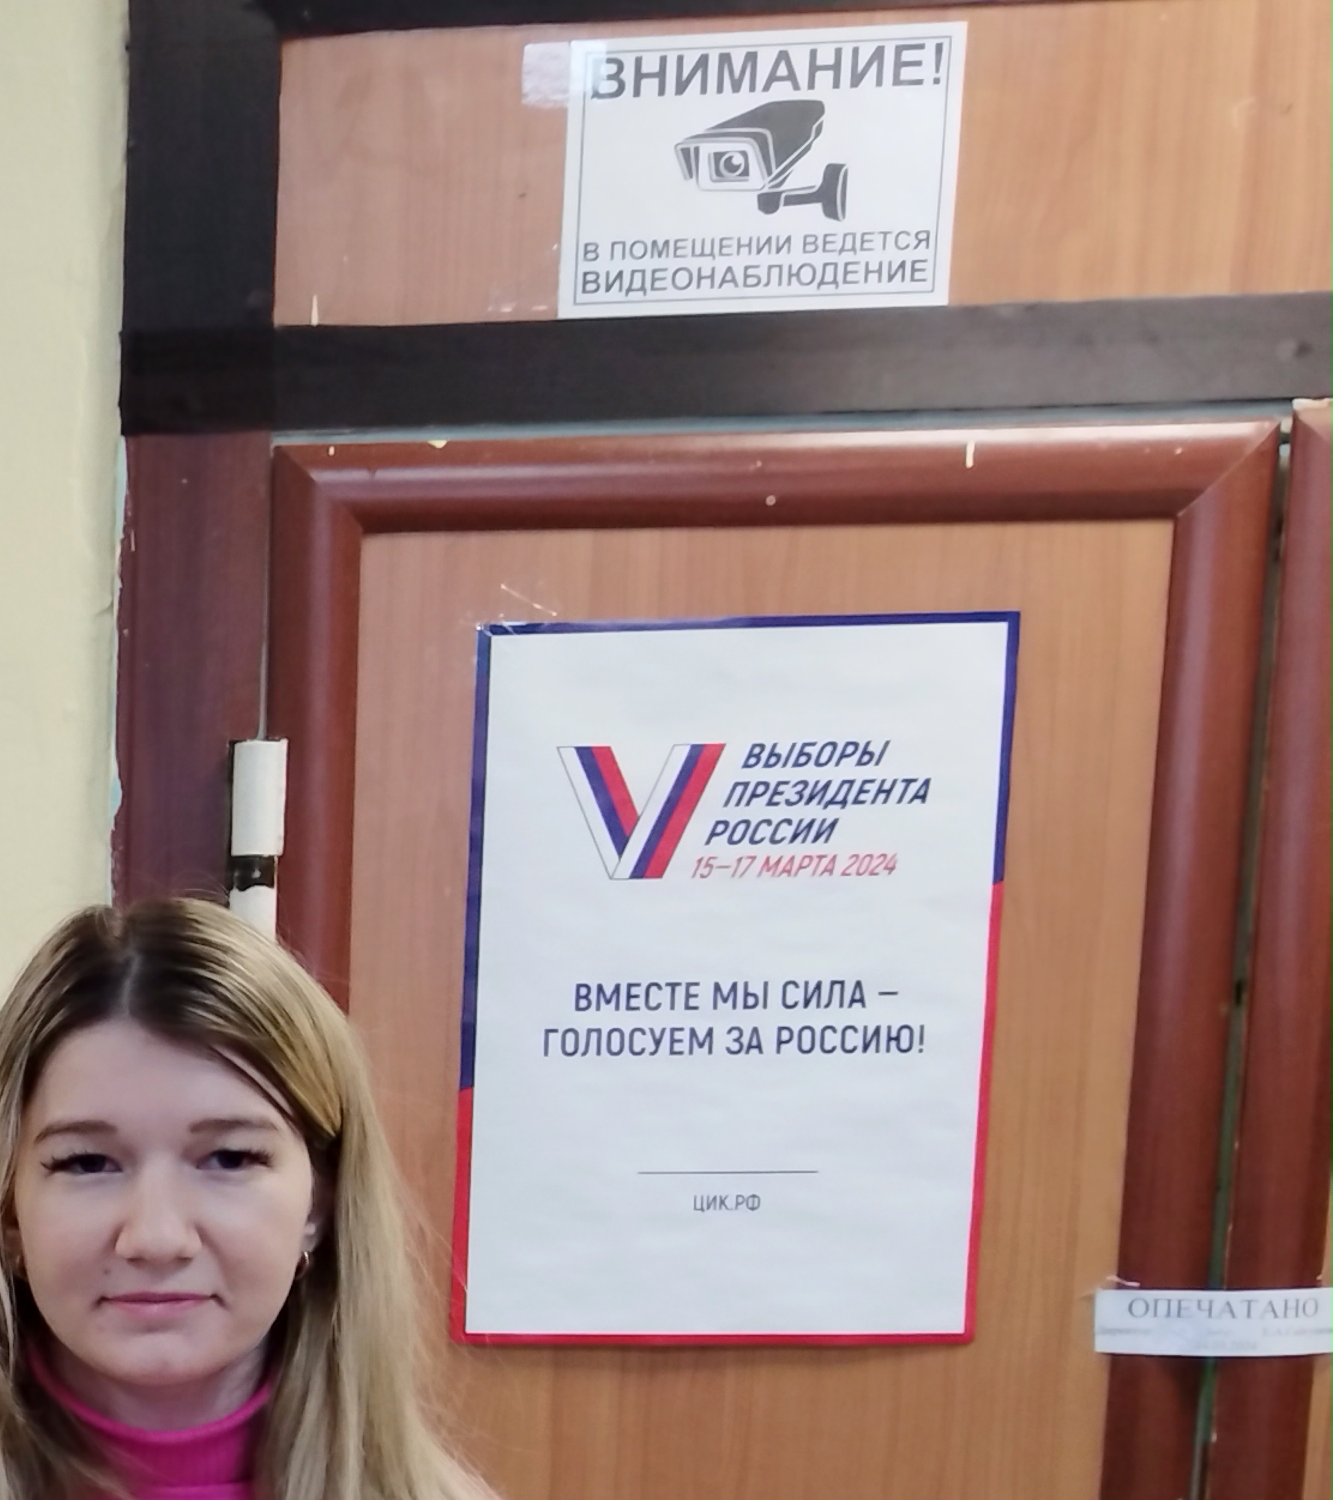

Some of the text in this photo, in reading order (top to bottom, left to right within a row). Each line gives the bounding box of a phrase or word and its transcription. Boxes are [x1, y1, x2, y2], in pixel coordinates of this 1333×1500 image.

[591, 42, 944, 100] ВНИМАНИЕ!
[583, 229, 930, 262] В ПОМЕЩЕНИИ ВЕДЕТСЯ
[581, 259, 928, 296] ВИДЕОНАБЛЮДЕНИЕ
[741, 740, 890, 769] ВЫБОРЫ
[723, 777, 932, 810] ПРЕЗИДЕНТА
[705, 818, 839, 846] РОССИИ
[757, 854, 836, 878] МАРТА
[840, 853, 899, 877] 2024
[574, 981, 700, 1012] ВМЕСТЕ
[712, 980, 769, 1011] МЫ
[781, 979, 866, 1010] СИЛА
[544, 1024, 925, 1057] ГОЛОСУЕМ ЗА РОССИЮ!
[693, 1193, 762, 1212] ЦИК.РФ
[1128, 1297, 1319, 1319] ОПЕЧАТАНО
